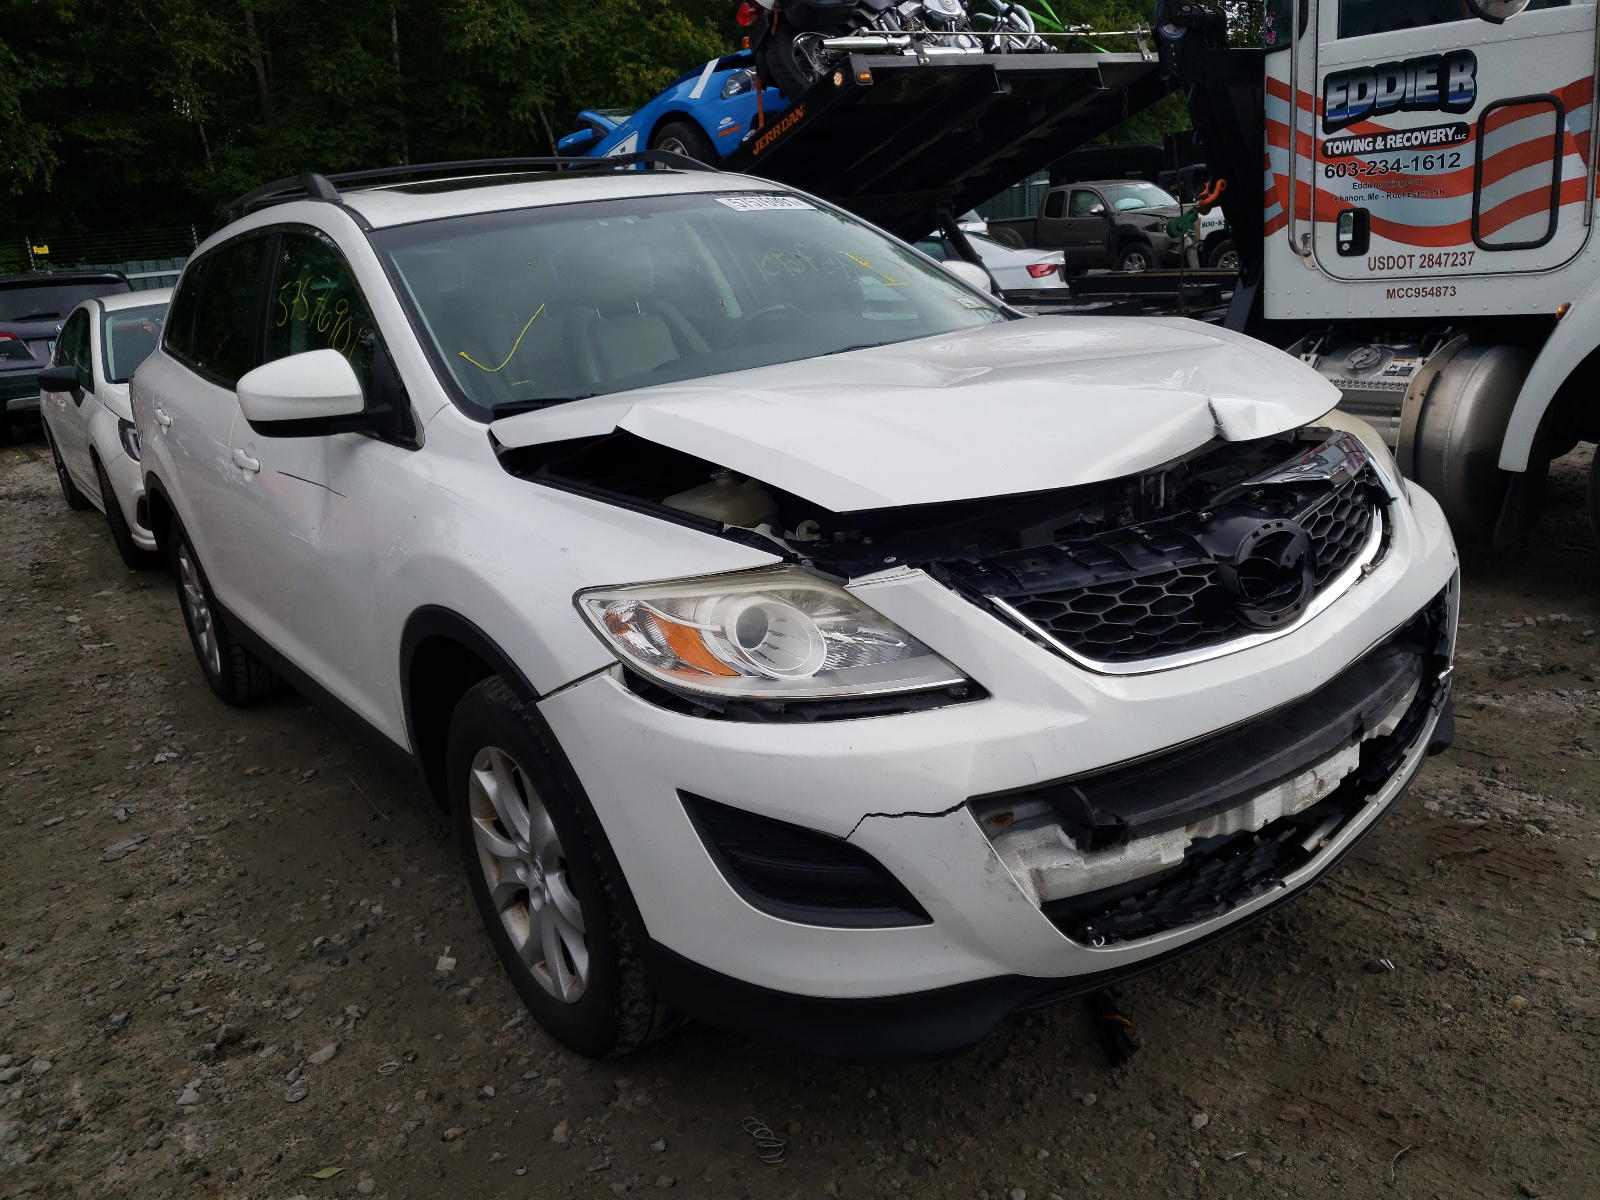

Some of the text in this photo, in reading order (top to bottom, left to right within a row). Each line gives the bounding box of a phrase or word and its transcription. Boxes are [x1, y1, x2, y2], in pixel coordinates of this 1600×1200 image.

[1325, 52, 1477, 126] EDDIE B
[1325, 138, 1374, 155] TOWING
[1375, 136, 1385, 150] &
[1386, 127, 1457, 148] RECOVERY
[1324, 152, 1461, 179] 603-234-1612
[1368, 250, 1476, 271] USDOT 2847237
[1386, 285, 1457, 299] MCC954873
